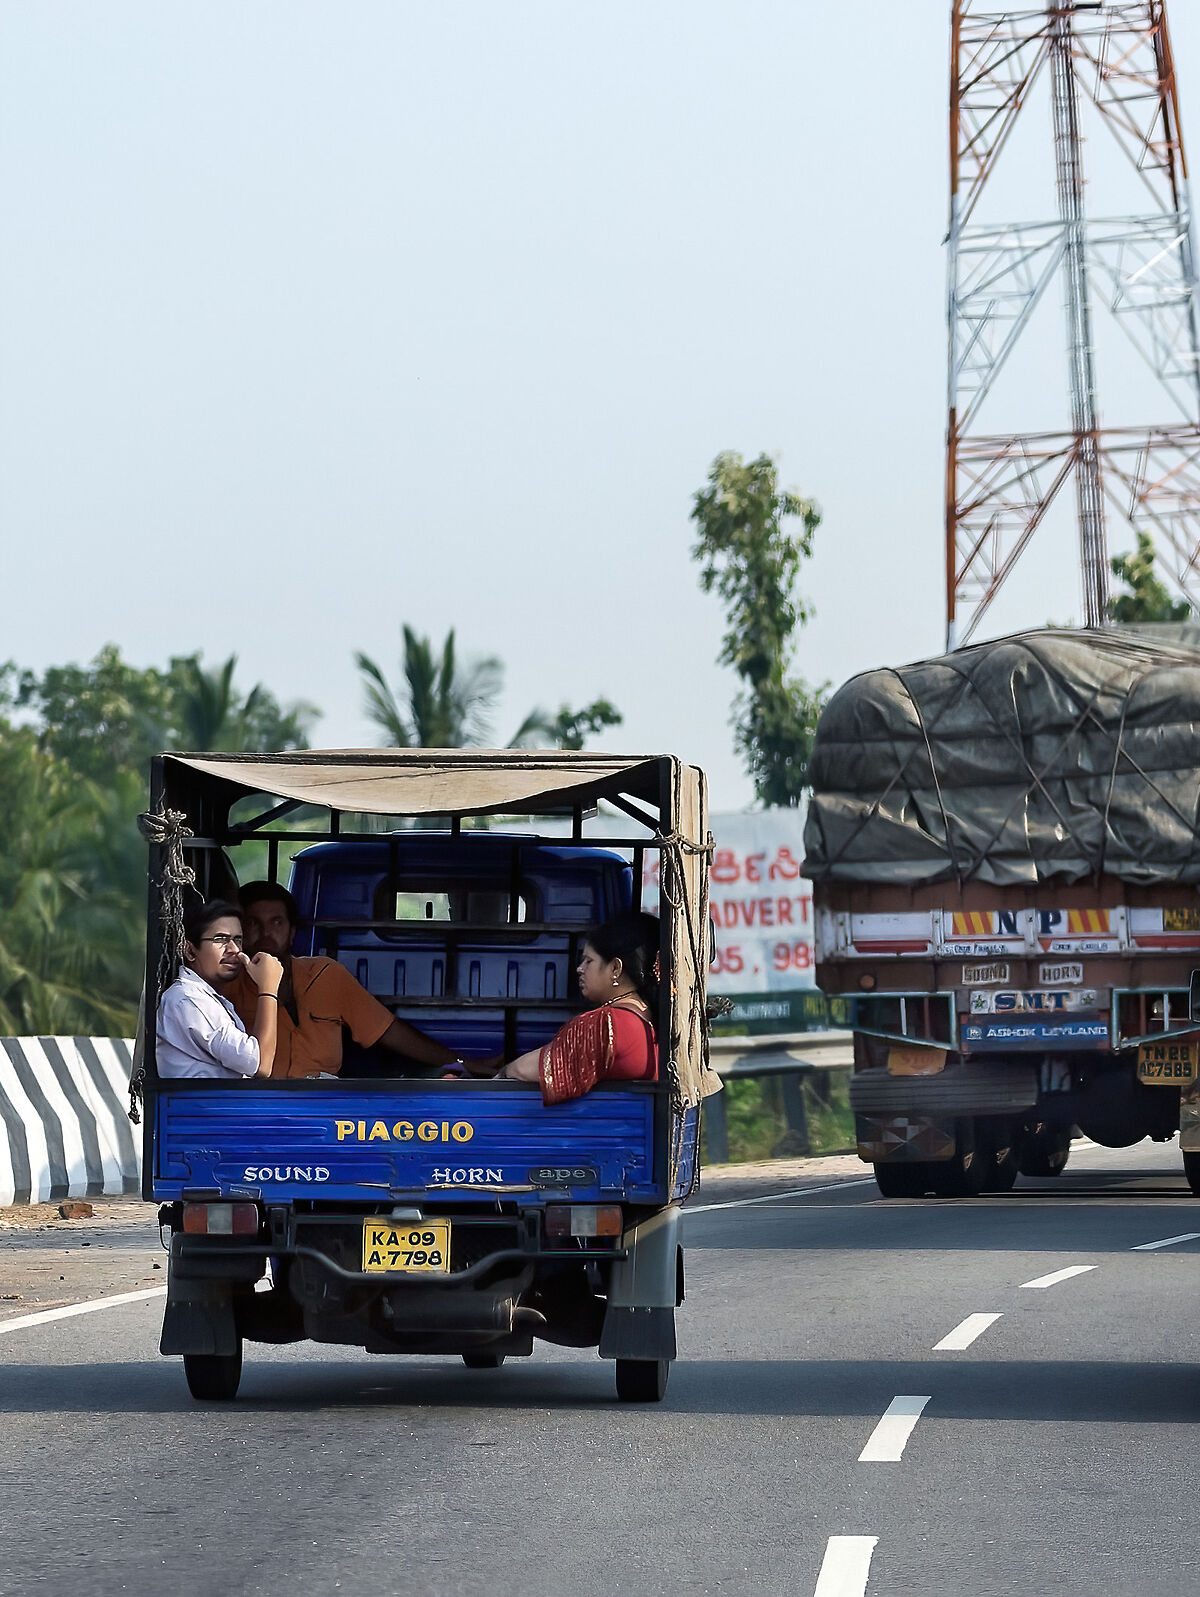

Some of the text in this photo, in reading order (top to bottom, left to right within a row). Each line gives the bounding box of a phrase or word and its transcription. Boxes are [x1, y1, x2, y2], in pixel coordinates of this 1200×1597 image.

[773, 942, 813, 971] 98
[1041, 965, 1081, 982] HORN
[986, 1026, 1109, 1038] ASHOK LEYLAND
[335, 1120, 475, 1143] PIAGGIO
[243, 1166, 504, 1184] SOUND HORN
[539, 1169, 586, 1181] ape
